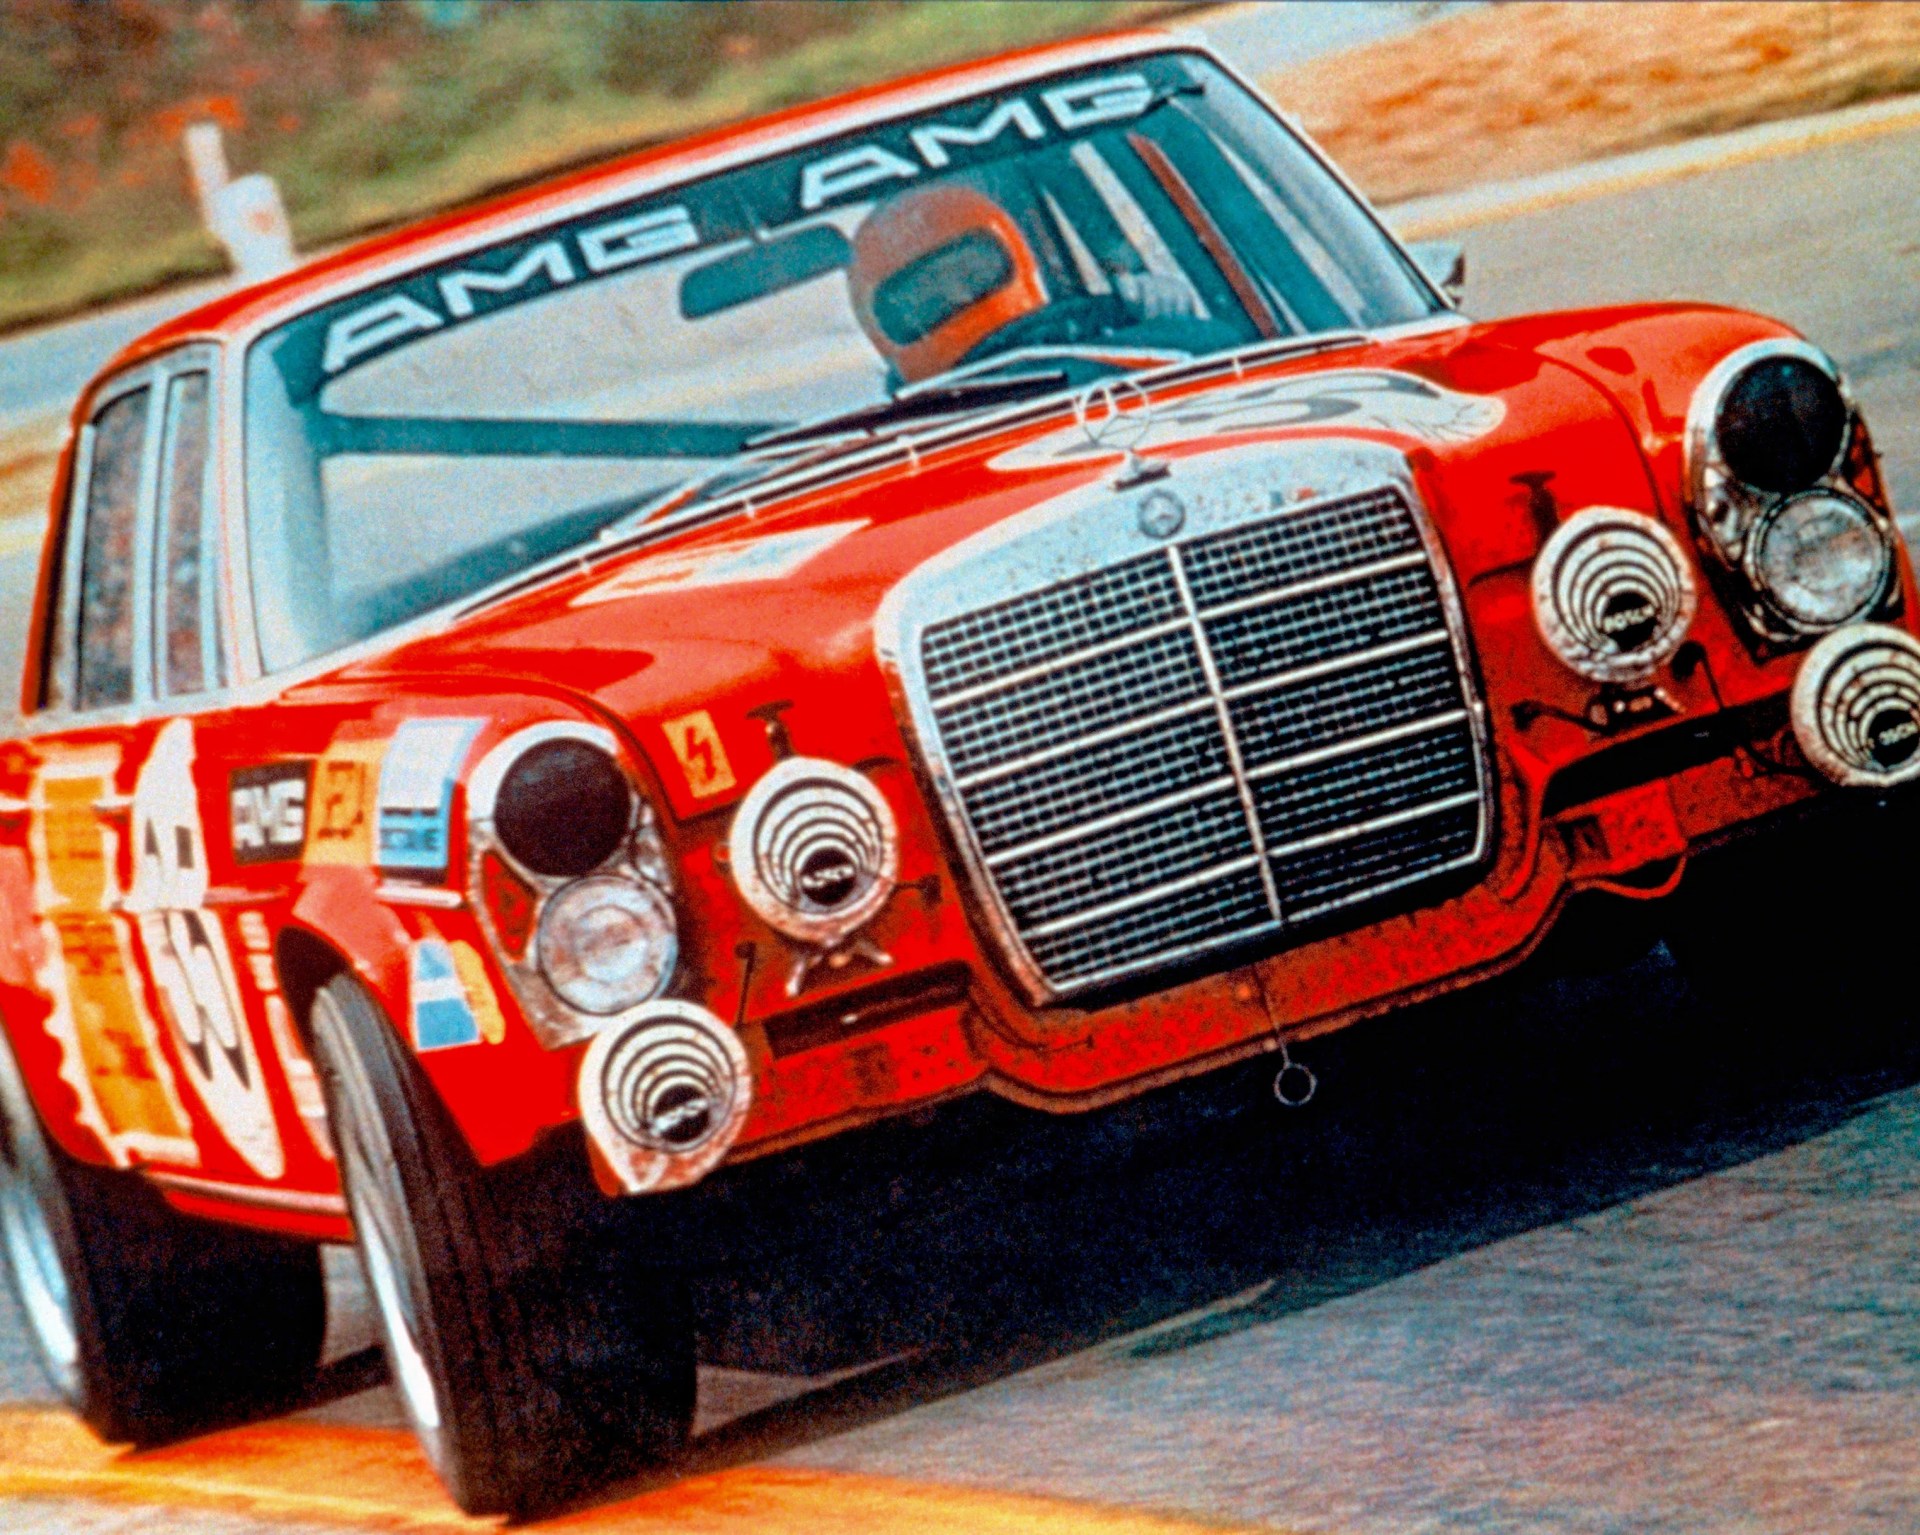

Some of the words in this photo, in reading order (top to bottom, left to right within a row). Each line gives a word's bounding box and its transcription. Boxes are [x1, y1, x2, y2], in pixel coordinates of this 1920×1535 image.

[323, 204, 699, 373] AMG
[802, 73, 1156, 210] AMG
[231, 778, 306, 851] AMG
